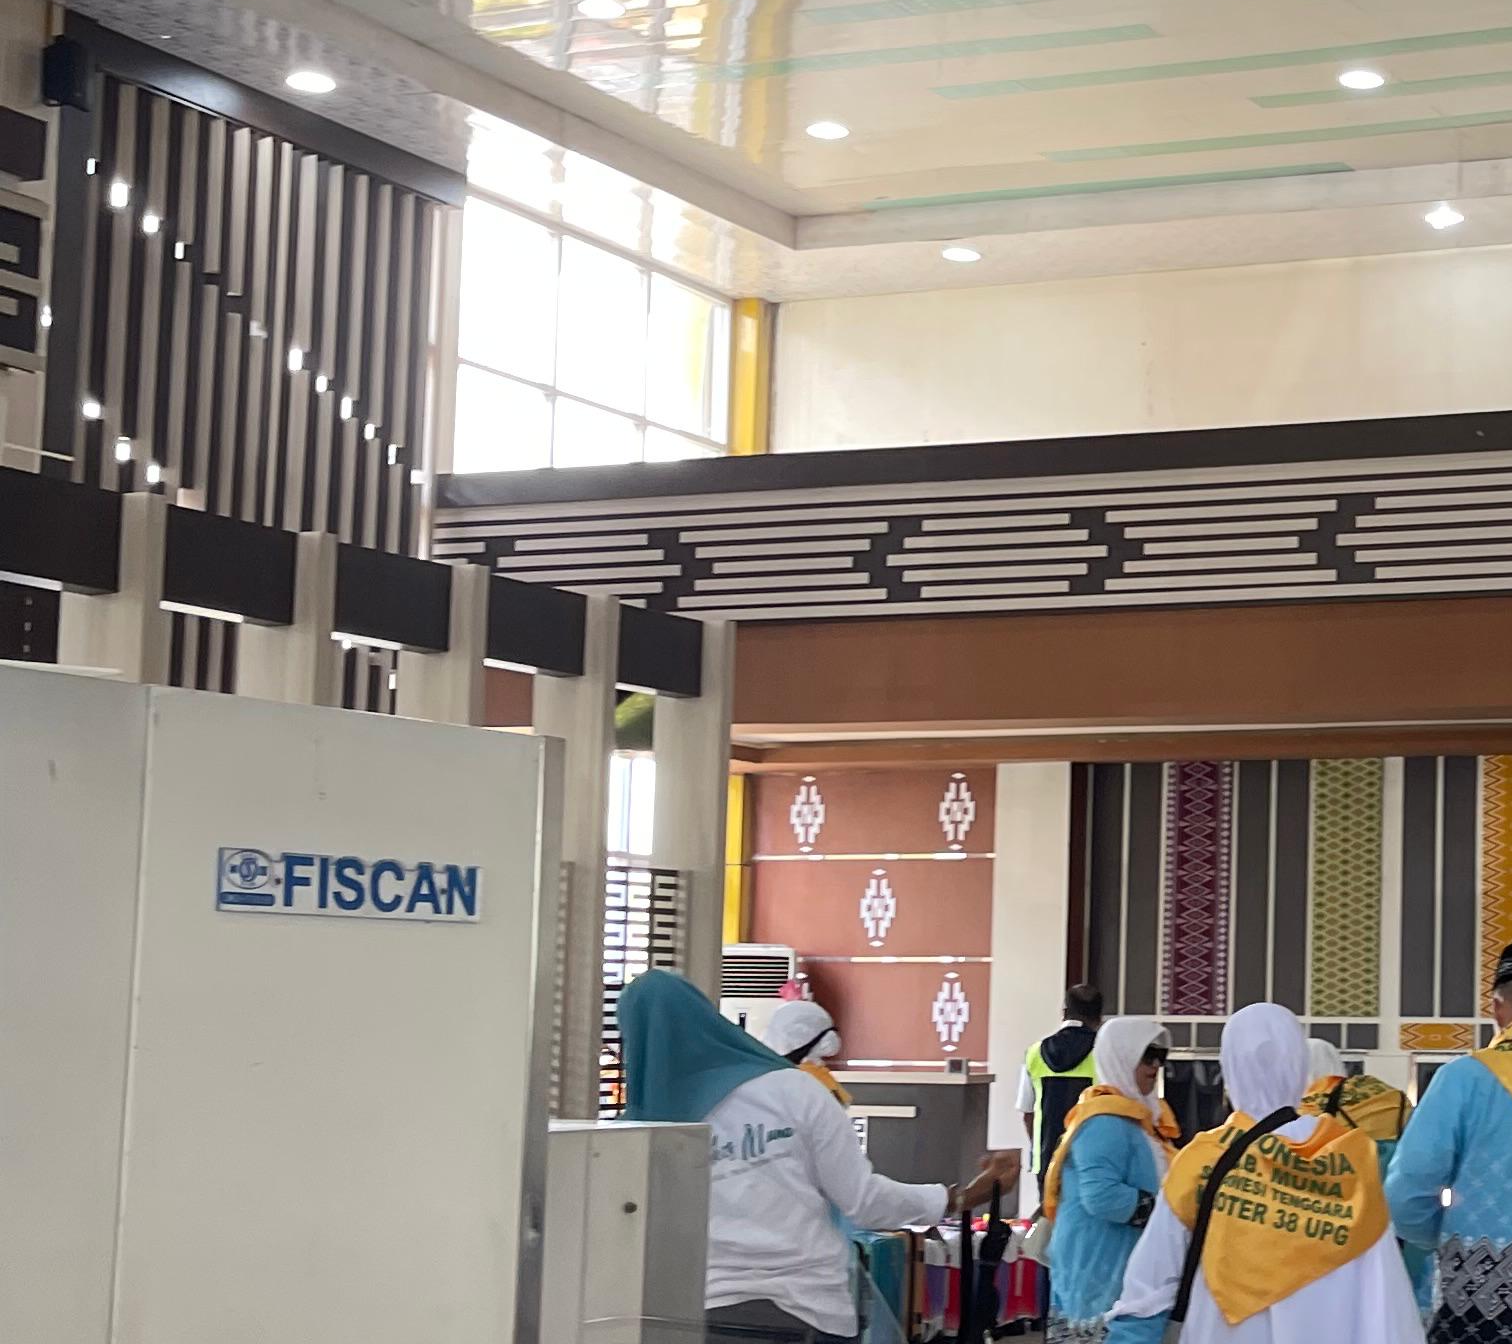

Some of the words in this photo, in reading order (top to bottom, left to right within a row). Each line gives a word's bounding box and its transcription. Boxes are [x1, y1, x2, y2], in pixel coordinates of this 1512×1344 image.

[283, 853, 478, 916] FISCAN
[1219, 1126, 1355, 1176] IONESIA
[1271, 1166, 1344, 1198] MUNA
[1271, 1187, 1354, 1219] TENGGARA
[1197, 1184, 1268, 1224] OTER
[1273, 1208, 1299, 1233] 38
[1305, 1216, 1350, 1246] UPG
